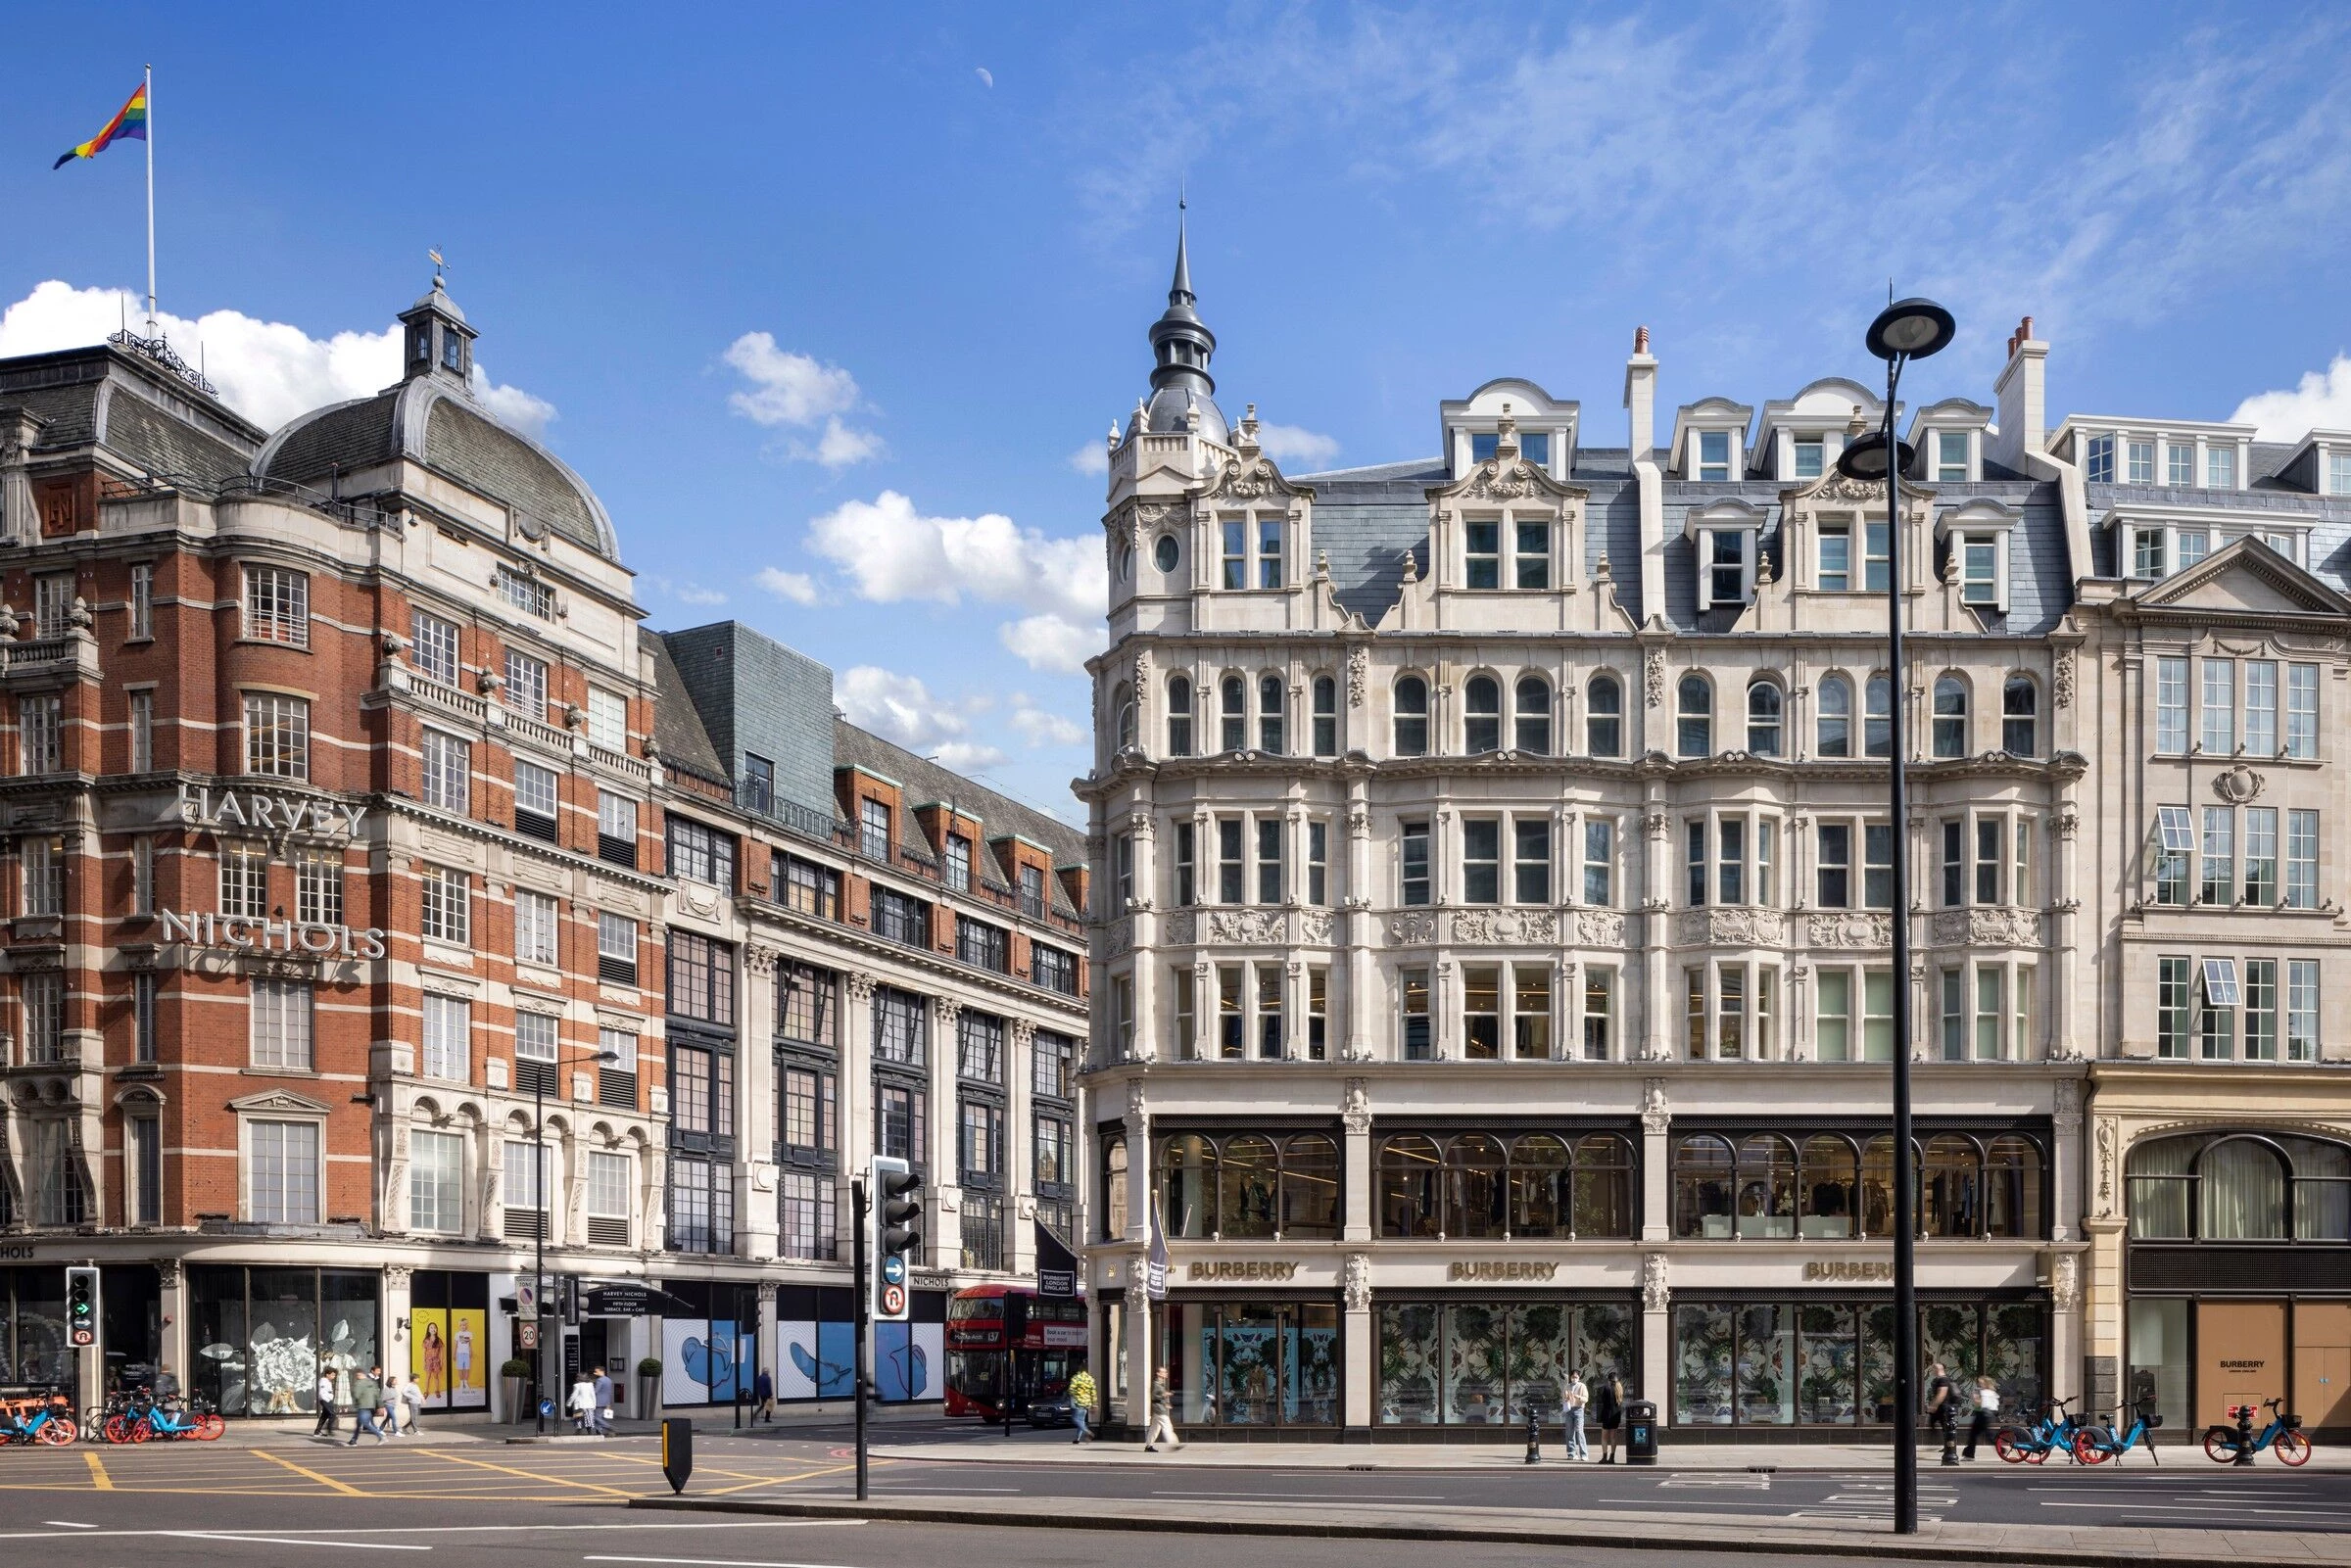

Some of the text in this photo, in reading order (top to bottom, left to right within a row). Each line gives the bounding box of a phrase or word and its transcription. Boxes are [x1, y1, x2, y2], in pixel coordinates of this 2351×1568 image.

[178, 784, 367, 837] HARVEY
[163, 908, 385, 960] NICHOLS
[1191, 1261, 1300, 1277] BURBERRY
[1452, 1261, 1560, 1277] BURBERRY
[1806, 1261, 1895, 1277] BURBER
[913, 1276, 949, 1287] NICHOLS
[523, 1331, 534, 1341] 20
[987, 1332, 999, 1342] 137
